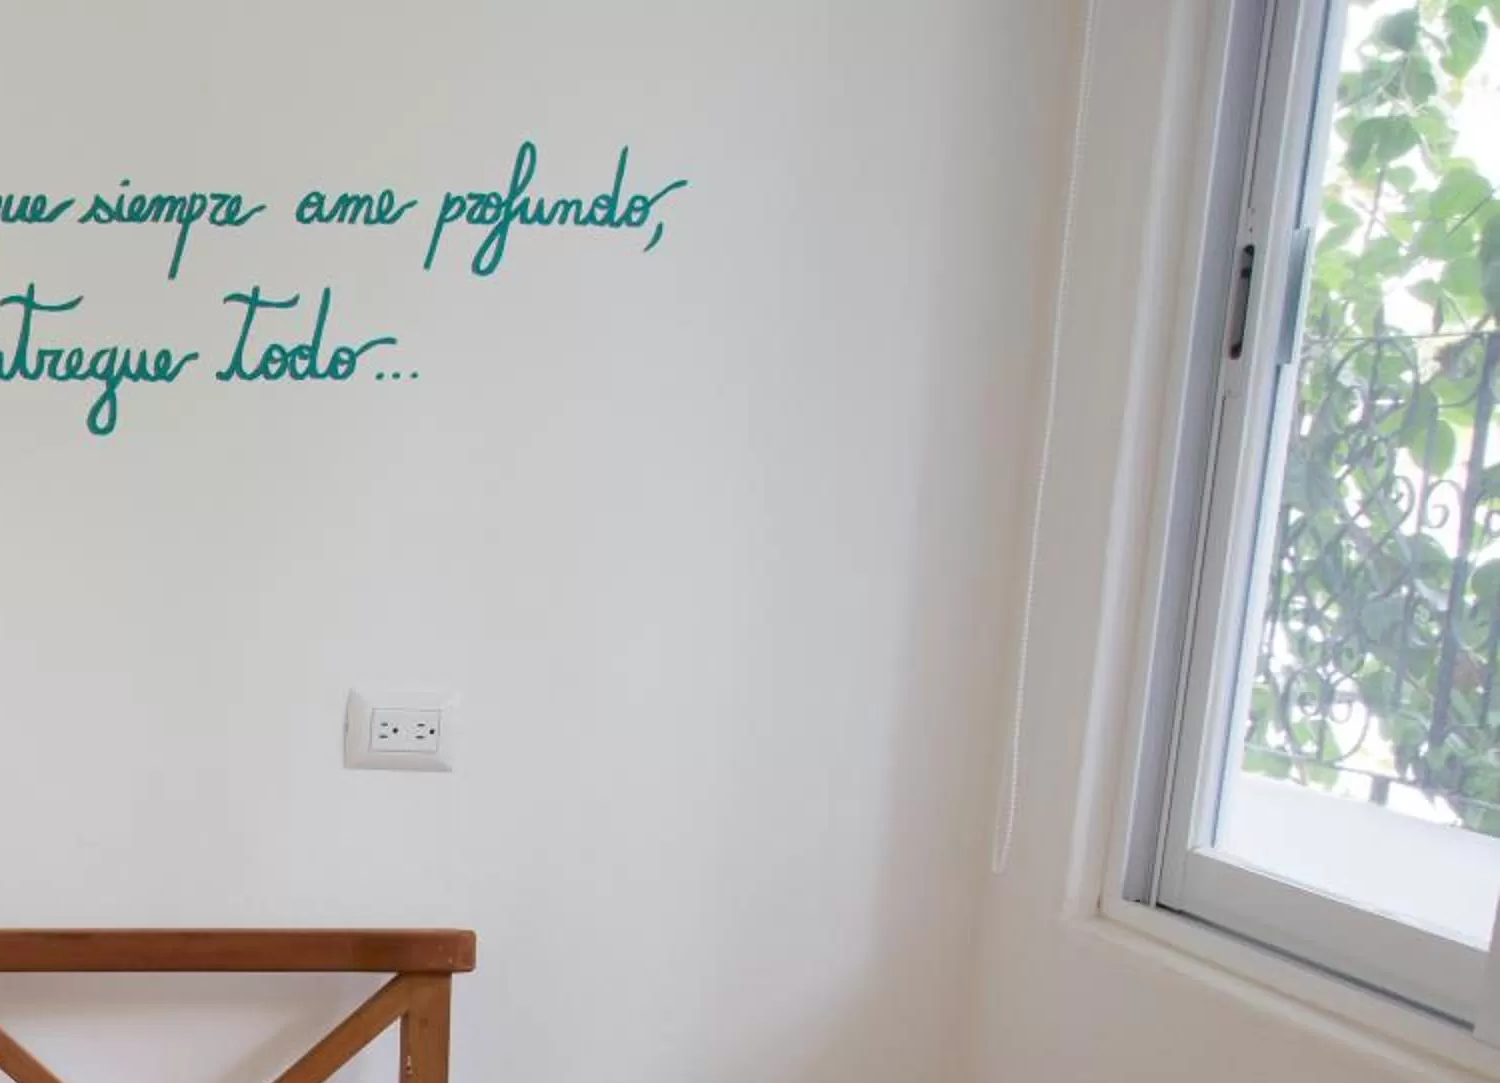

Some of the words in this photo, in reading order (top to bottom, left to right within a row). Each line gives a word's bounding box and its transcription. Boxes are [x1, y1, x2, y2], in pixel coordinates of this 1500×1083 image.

[77, 179, 266, 281] siempre
[295, 189, 418, 226] ame
[423, 140, 688, 276] profundo,
